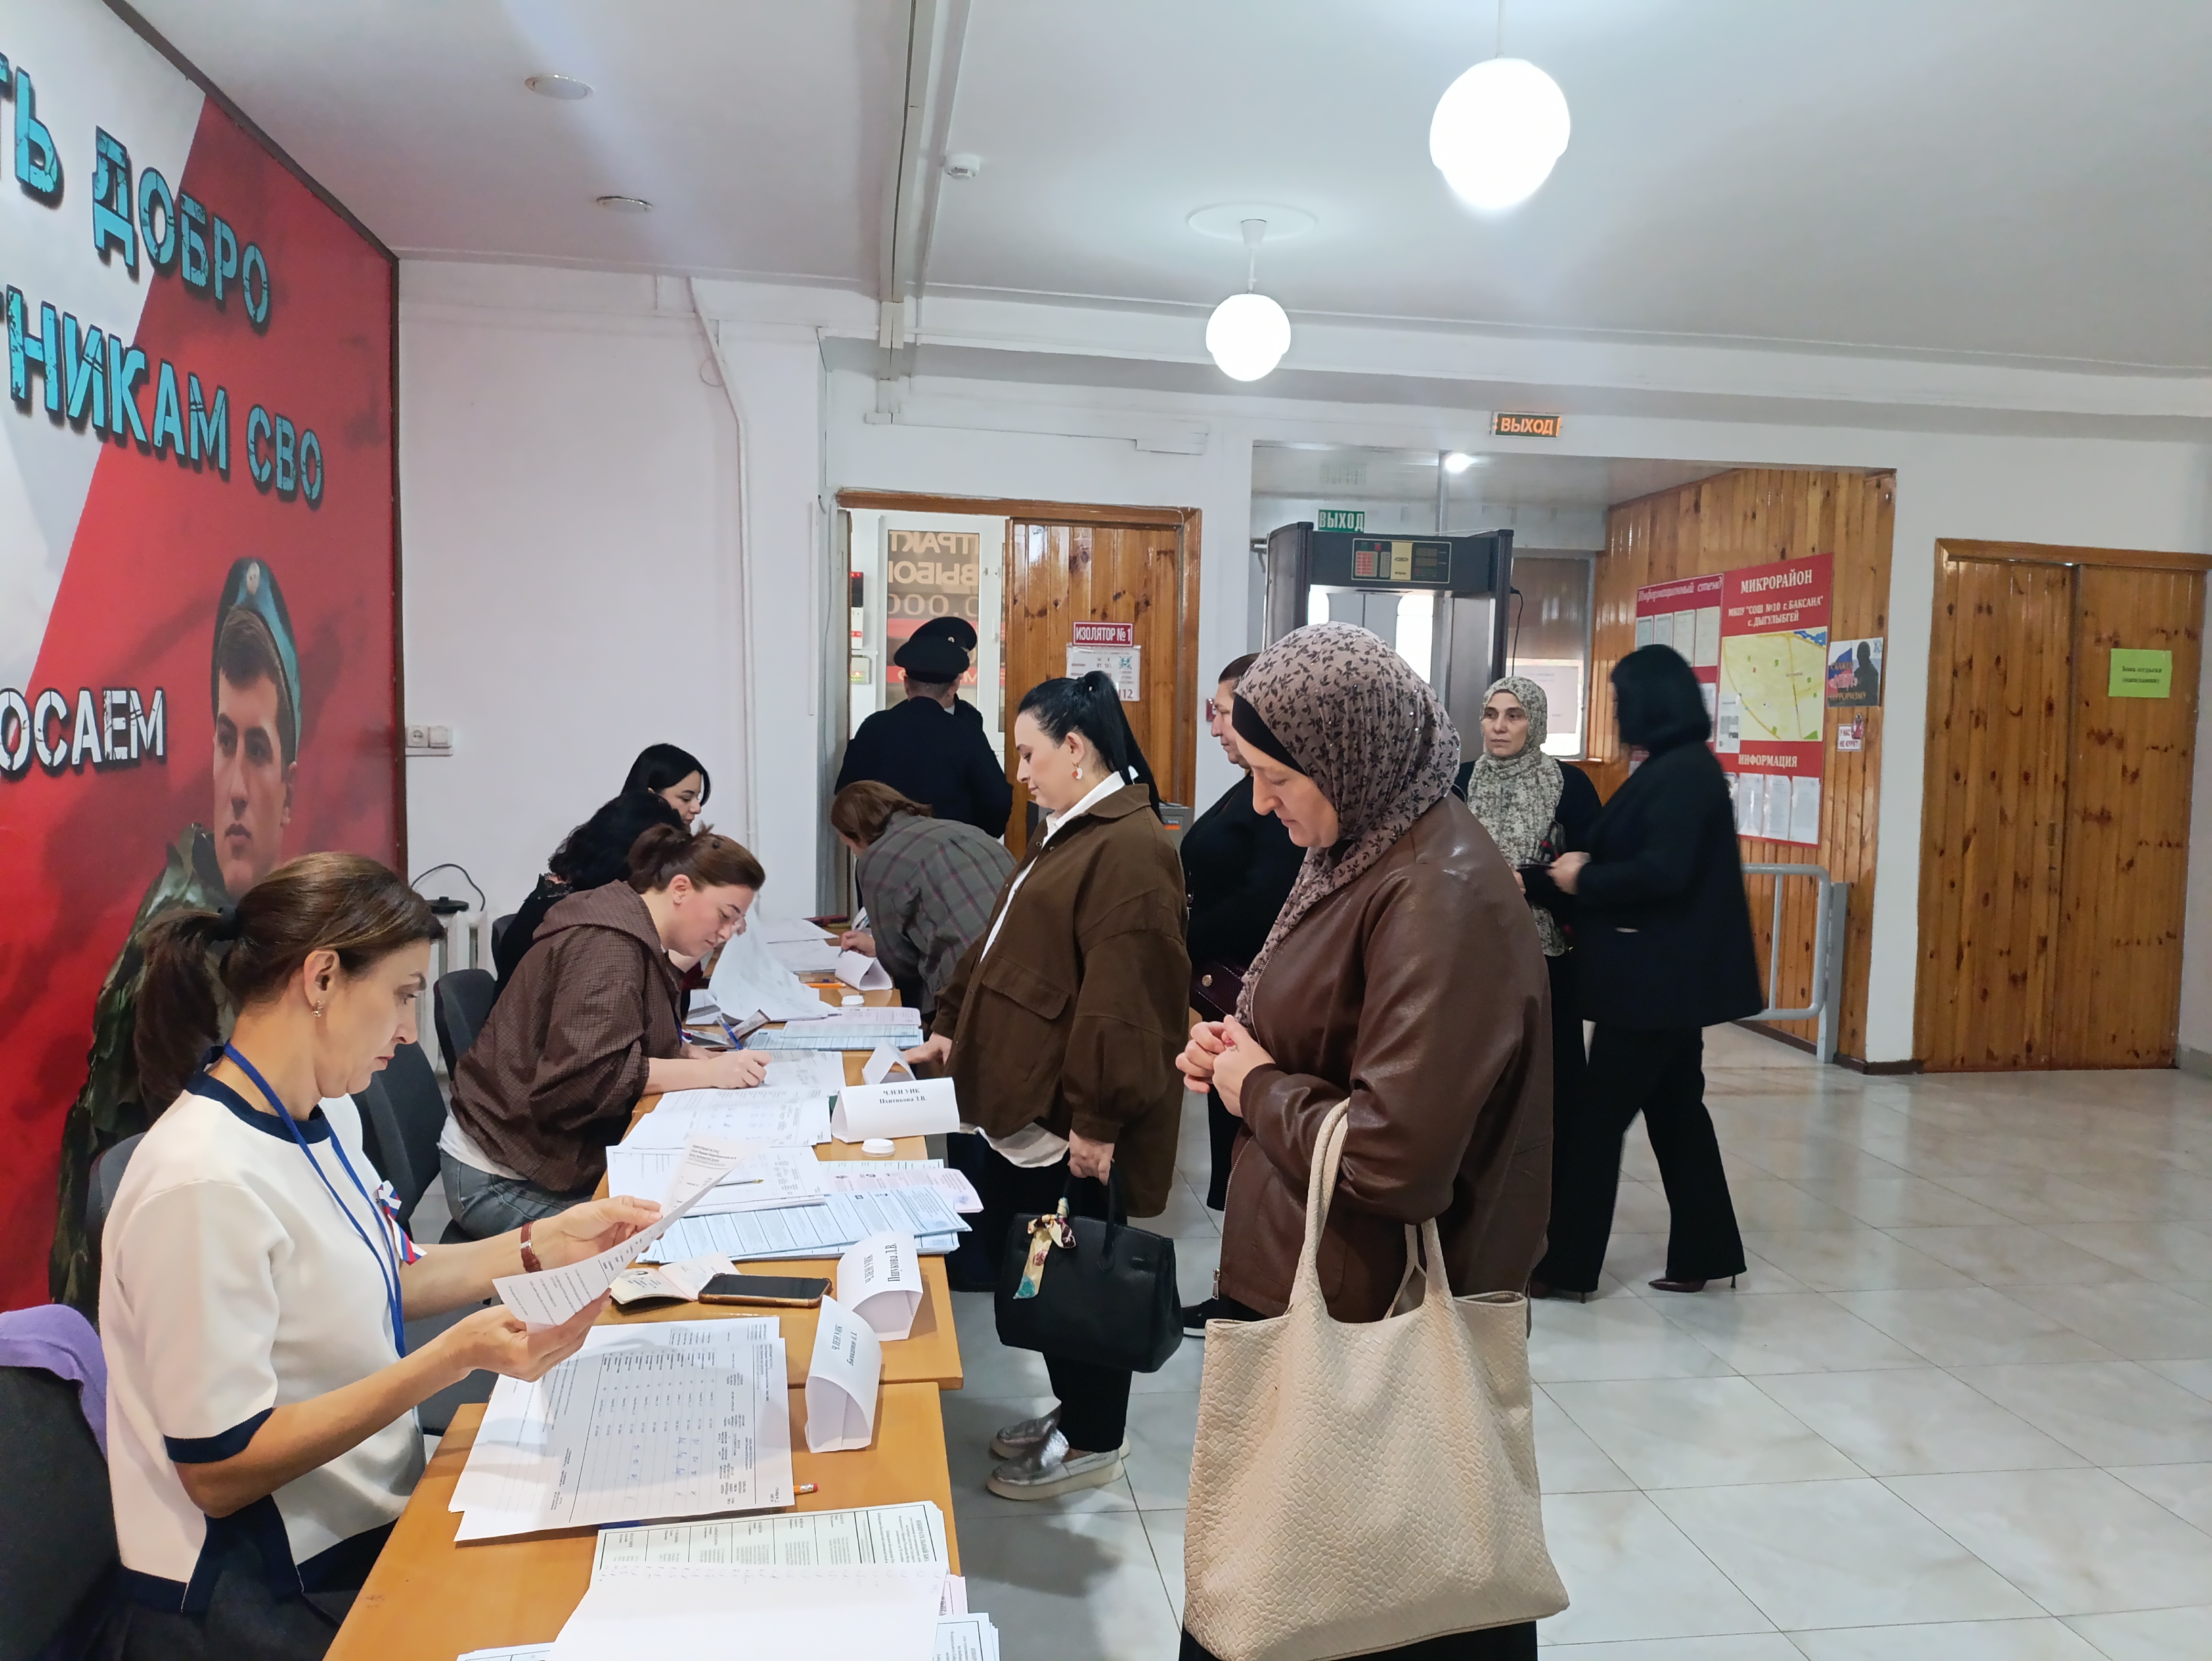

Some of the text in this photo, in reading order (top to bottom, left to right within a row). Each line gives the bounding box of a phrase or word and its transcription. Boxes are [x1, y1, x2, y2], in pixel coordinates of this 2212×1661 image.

[91, 125, 269, 325] ДОБРО
[1501, 417, 1553, 435] ВЫХОД
[246, 404, 322, 501] СВО
[1319, 511, 1365, 532] ВЫХОД
[1740, 568, 1813, 594] МИКРОРАЙОН
[1789, 596, 1824, 610] БАКСАНА"
[1076, 627, 1131, 642] ИЗОЛЯТОР № 1
[0, 688, 166, 771] ОСАЕМ
[1738, 754, 1798, 769] ИНФОРМАЦИЯ
[864, 1254, 874, 1284] ЧЛЕН УИК
[888, 1256, 902, 1282] Пшукова
[831, 1335, 841, 1350] ЧЛЕН
[916, 1520, 929, 1553] ИЗБИРАТЕЛЬНЫЙ
